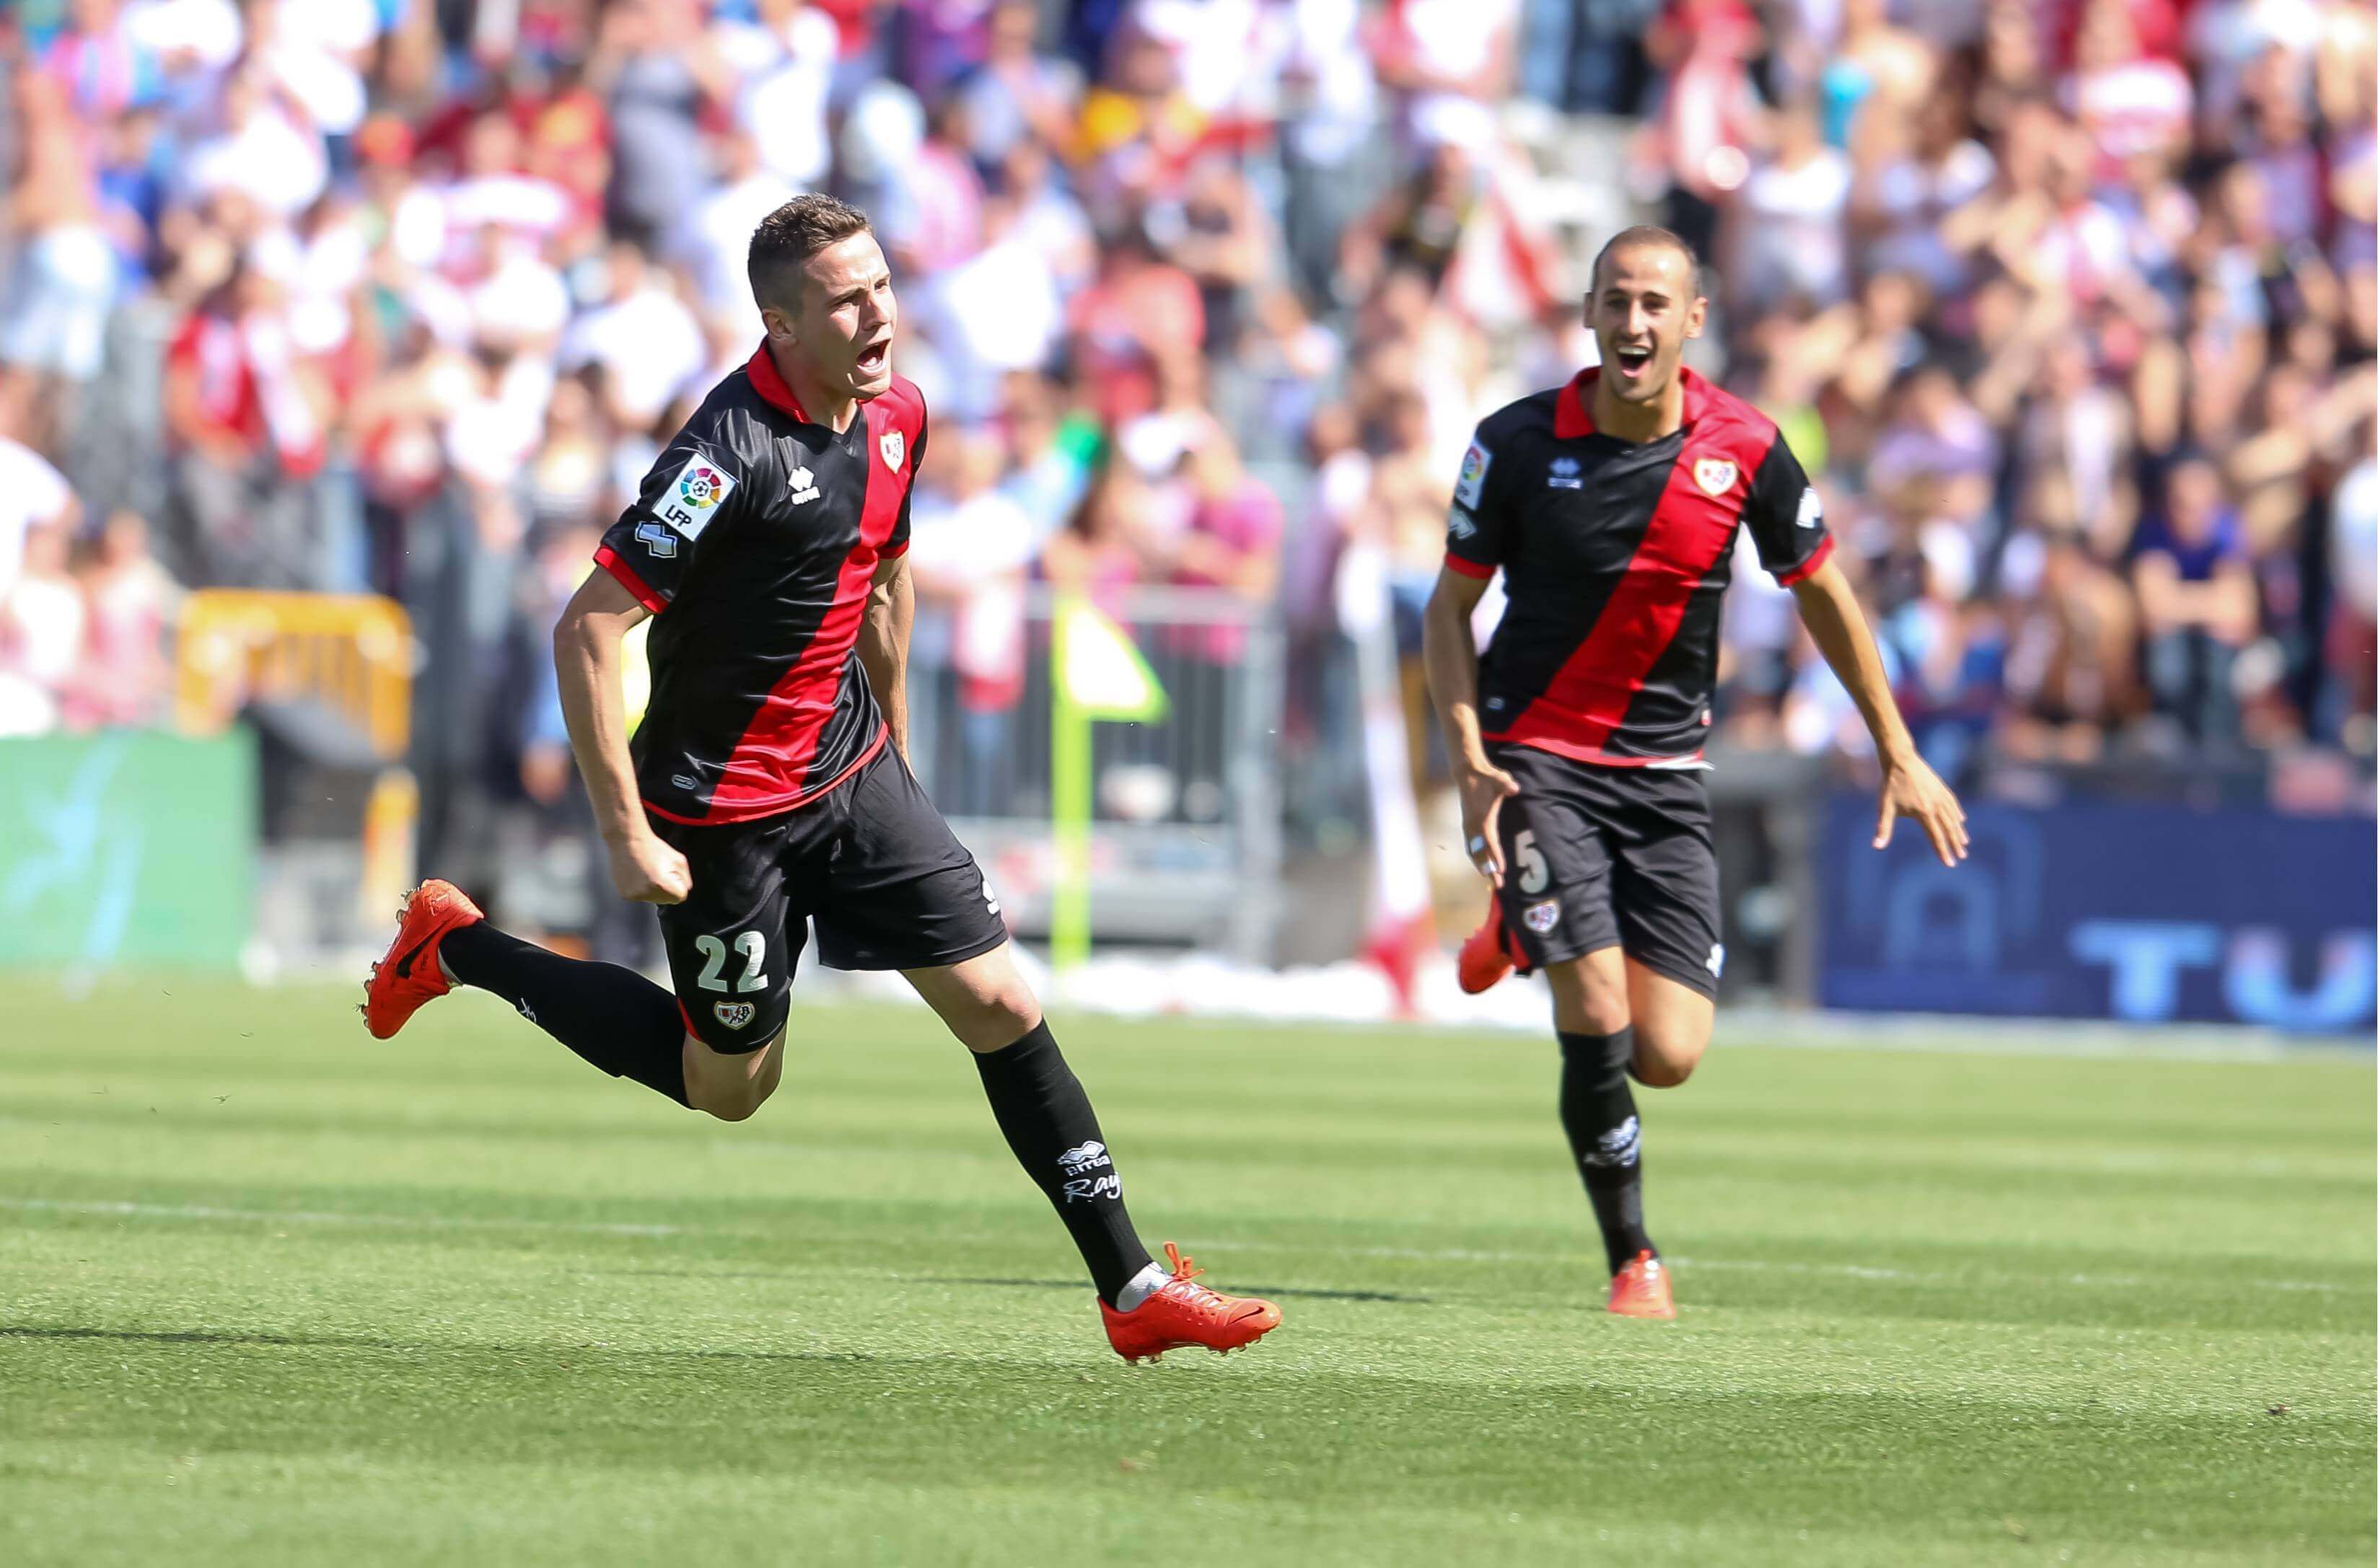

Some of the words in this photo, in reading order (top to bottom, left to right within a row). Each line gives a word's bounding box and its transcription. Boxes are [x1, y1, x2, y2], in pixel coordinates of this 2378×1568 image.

[664, 504, 692, 527] LFP
[1515, 829, 1549, 894] 5
[696, 930, 769, 992] 22
